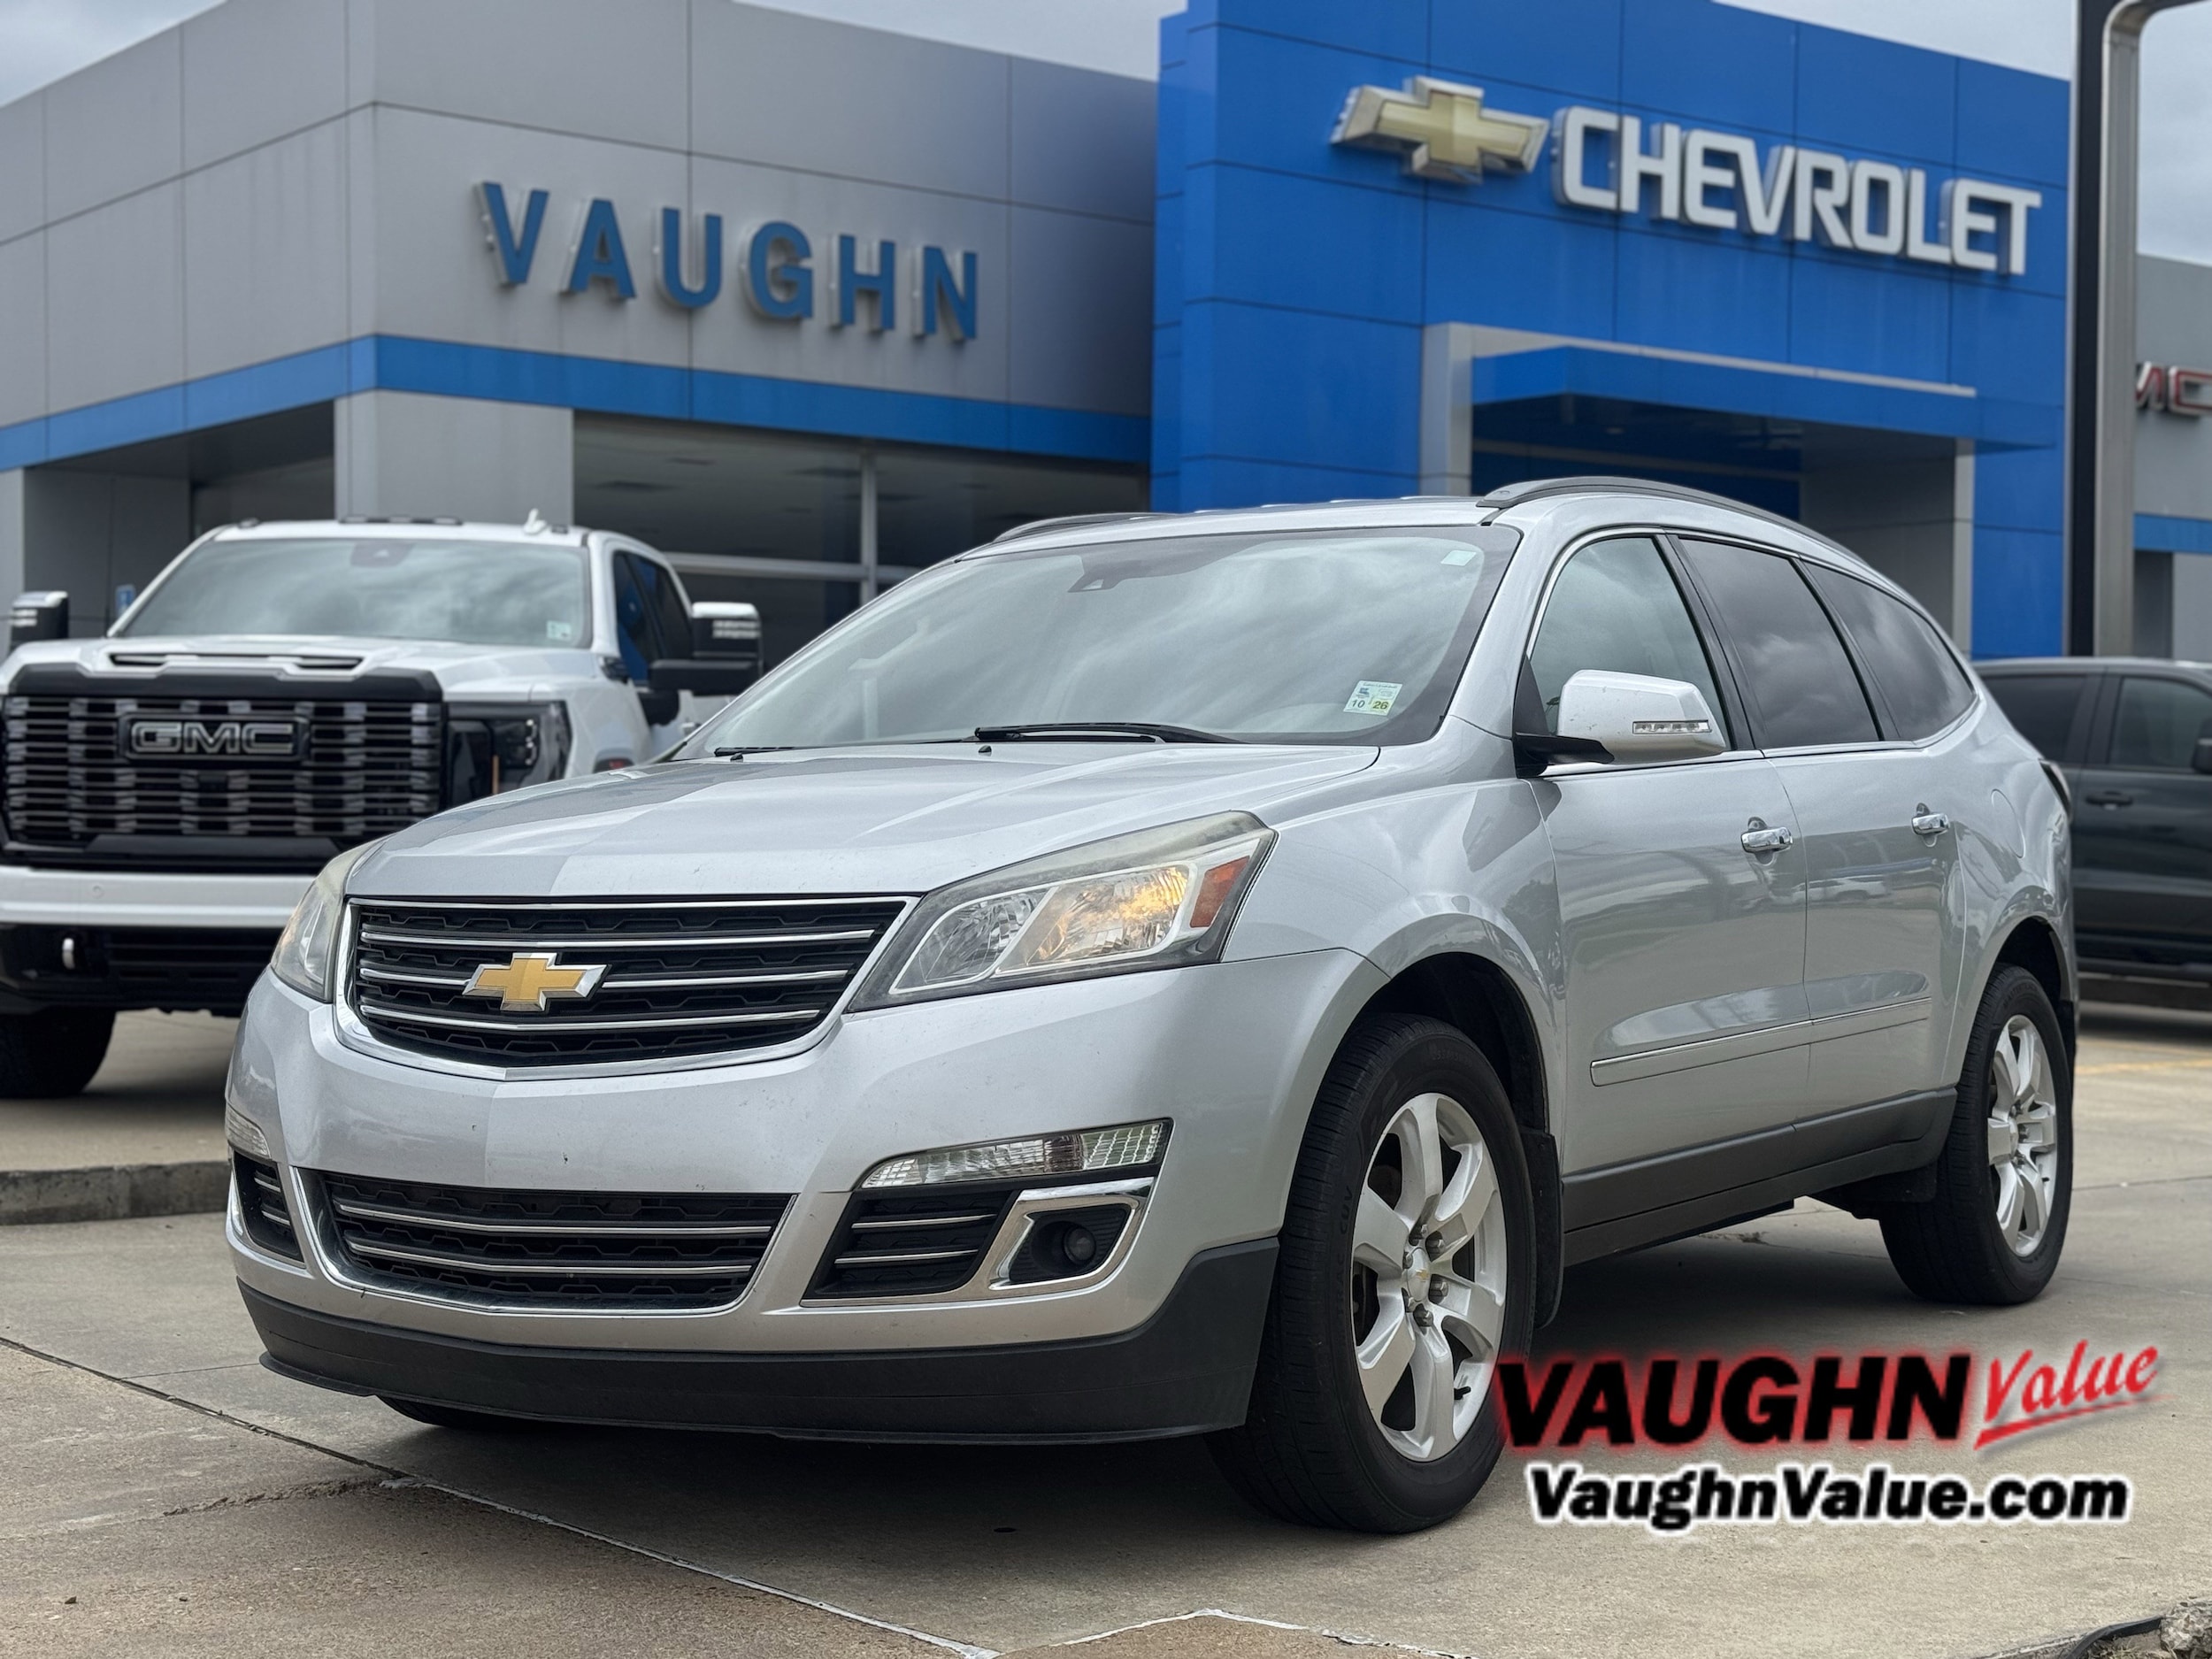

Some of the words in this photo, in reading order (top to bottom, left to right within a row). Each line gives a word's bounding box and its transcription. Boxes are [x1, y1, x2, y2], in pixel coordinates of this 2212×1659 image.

[1553, 105, 2041, 276] CHEVROLET
[474, 181, 978, 340] VAUGHN
[132, 721, 294, 754] GMC
[1352, 699, 1365, 709] 10
[1373, 701, 1389, 710] 26
